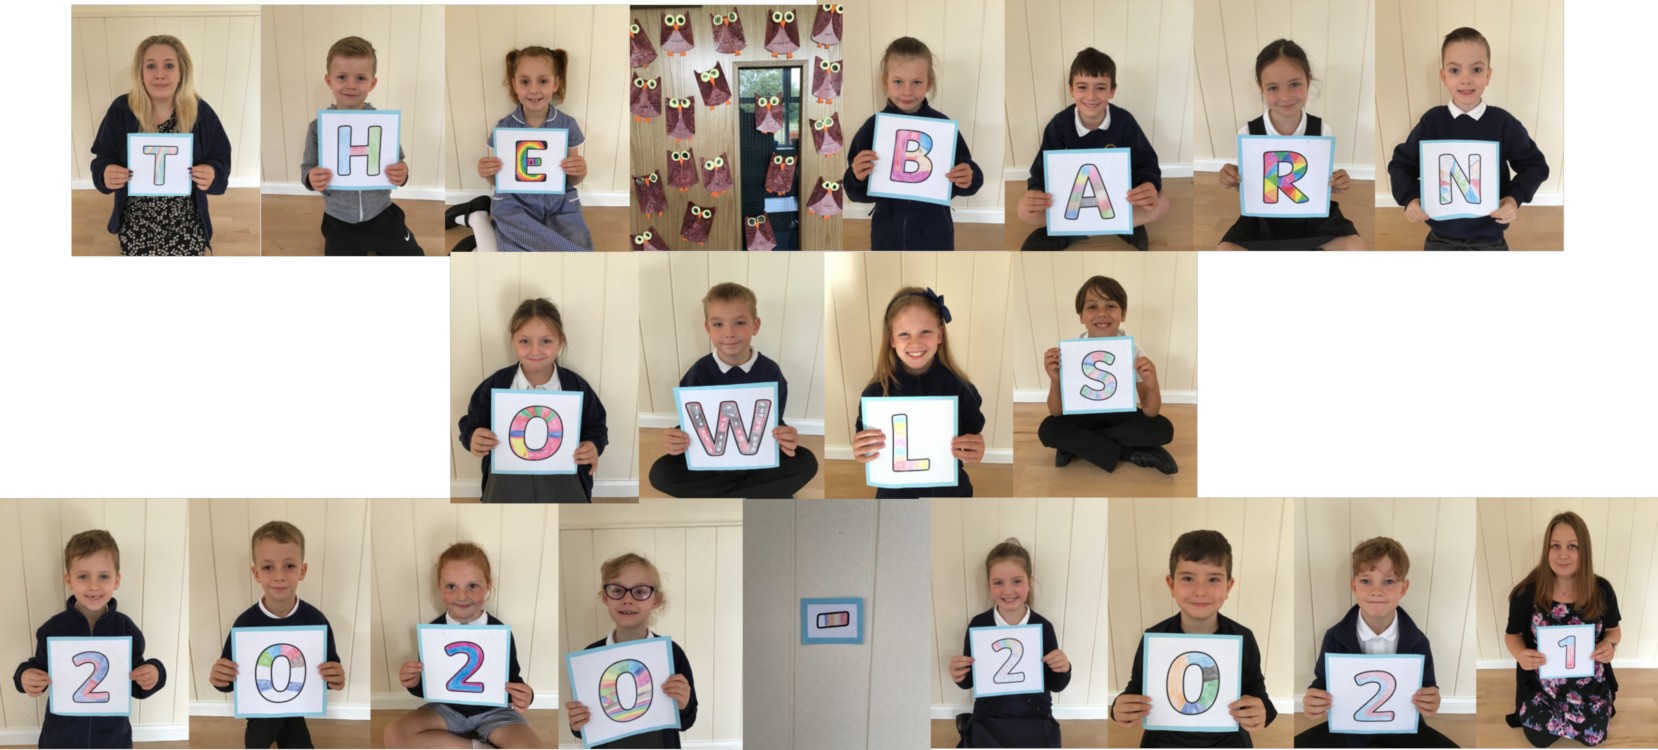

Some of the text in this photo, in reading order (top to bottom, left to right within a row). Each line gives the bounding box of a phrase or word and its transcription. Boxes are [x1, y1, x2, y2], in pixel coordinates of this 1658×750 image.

[143, 145, 179, 186] T
[337, 125, 382, 176] H
[515, 140, 548, 182] E
[890, 129, 933, 183] B
[1064, 163, 1115, 220] A
[1263, 150, 1309, 204] R
[1438, 153, 1482, 205] N
[1080, 350, 1117, 401] S
[508, 405, 564, 460] O
[686, 399, 771, 456] W
[891, 413, 931, 472] L
[72, 651, 110, 703] 2
[255, 643, 307, 703] 0
[444, 641, 485, 693] 2
[991, 638, 1025, 684] 2
[1558, 635, 1576, 669] 1
[598, 659, 654, 723] 0
[1166, 651, 1220, 714] 0
[1353, 670, 1397, 721] 2
